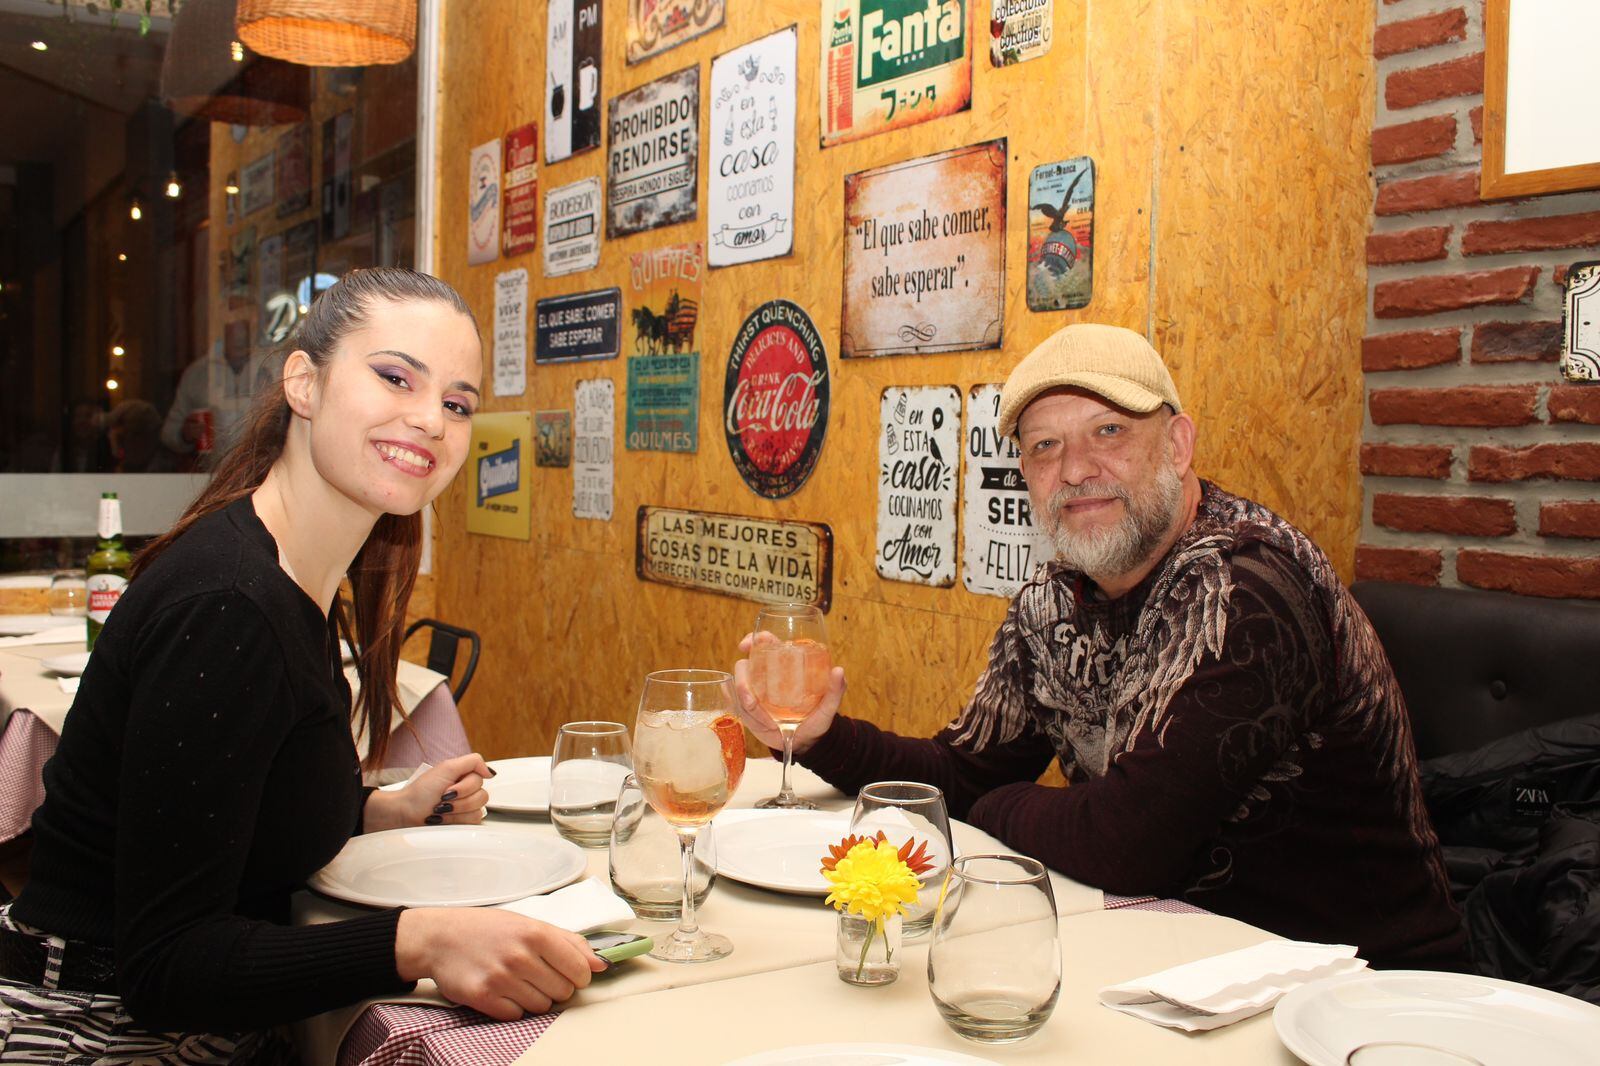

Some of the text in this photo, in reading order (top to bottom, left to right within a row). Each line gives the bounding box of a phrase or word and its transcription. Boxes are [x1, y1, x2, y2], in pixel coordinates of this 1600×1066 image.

[579, 3, 598, 32] PM
[551, 20, 568, 47] AM
[860, 0, 961, 81] Fanta
[740, 96, 755, 111] en
[613, 95, 690, 144] PROHIBIDO
[740, 110, 765, 140] esta
[612, 128, 690, 176] RENDIRSE
[720, 141, 779, 177] casa
[640, 176, 661, 193] HONDO
[662, 175, 668, 188] Y
[668, 168, 690, 187] SIGUE
[727, 175, 775, 202] cocinamos
[738, 204, 761, 220] con
[733, 225, 767, 247] amor
[880, 219, 905, 256] que
[908, 209, 939, 246] sabe
[942, 205, 991, 238] comer,
[871, 266, 900, 299] sabe
[538, 302, 616, 328] EL QUE SABE COMER
[549, 327, 603, 348] SABE ESPERAR
[731, 305, 821, 369] THIRST QUENCHING
[745, 331, 805, 369] DELICIOUS AND
[751, 372, 780, 386] DRINK
[726, 369, 827, 435] Coca-Cola
[909, 409, 923, 425] en
[629, 431, 692, 449] QUILMES
[903, 430, 929, 452] ESTA
[891, 456, 943, 491] casa
[1003, 470, 1017, 487] de
[888, 495, 943, 521] COCINAMOS
[987, 496, 1032, 527] SER
[662, 516, 798, 549] LAS MEJORES
[913, 524, 932, 539] con
[650, 538, 813, 581] COSAS DE LA VIDA
[883, 524, 942, 578] Amor
[986, 540, 1031, 582] FELIZ
[650, 560, 812, 601] MERECEN SER COMPARTIDAS
[1516, 787, 1549, 803] ZARA
